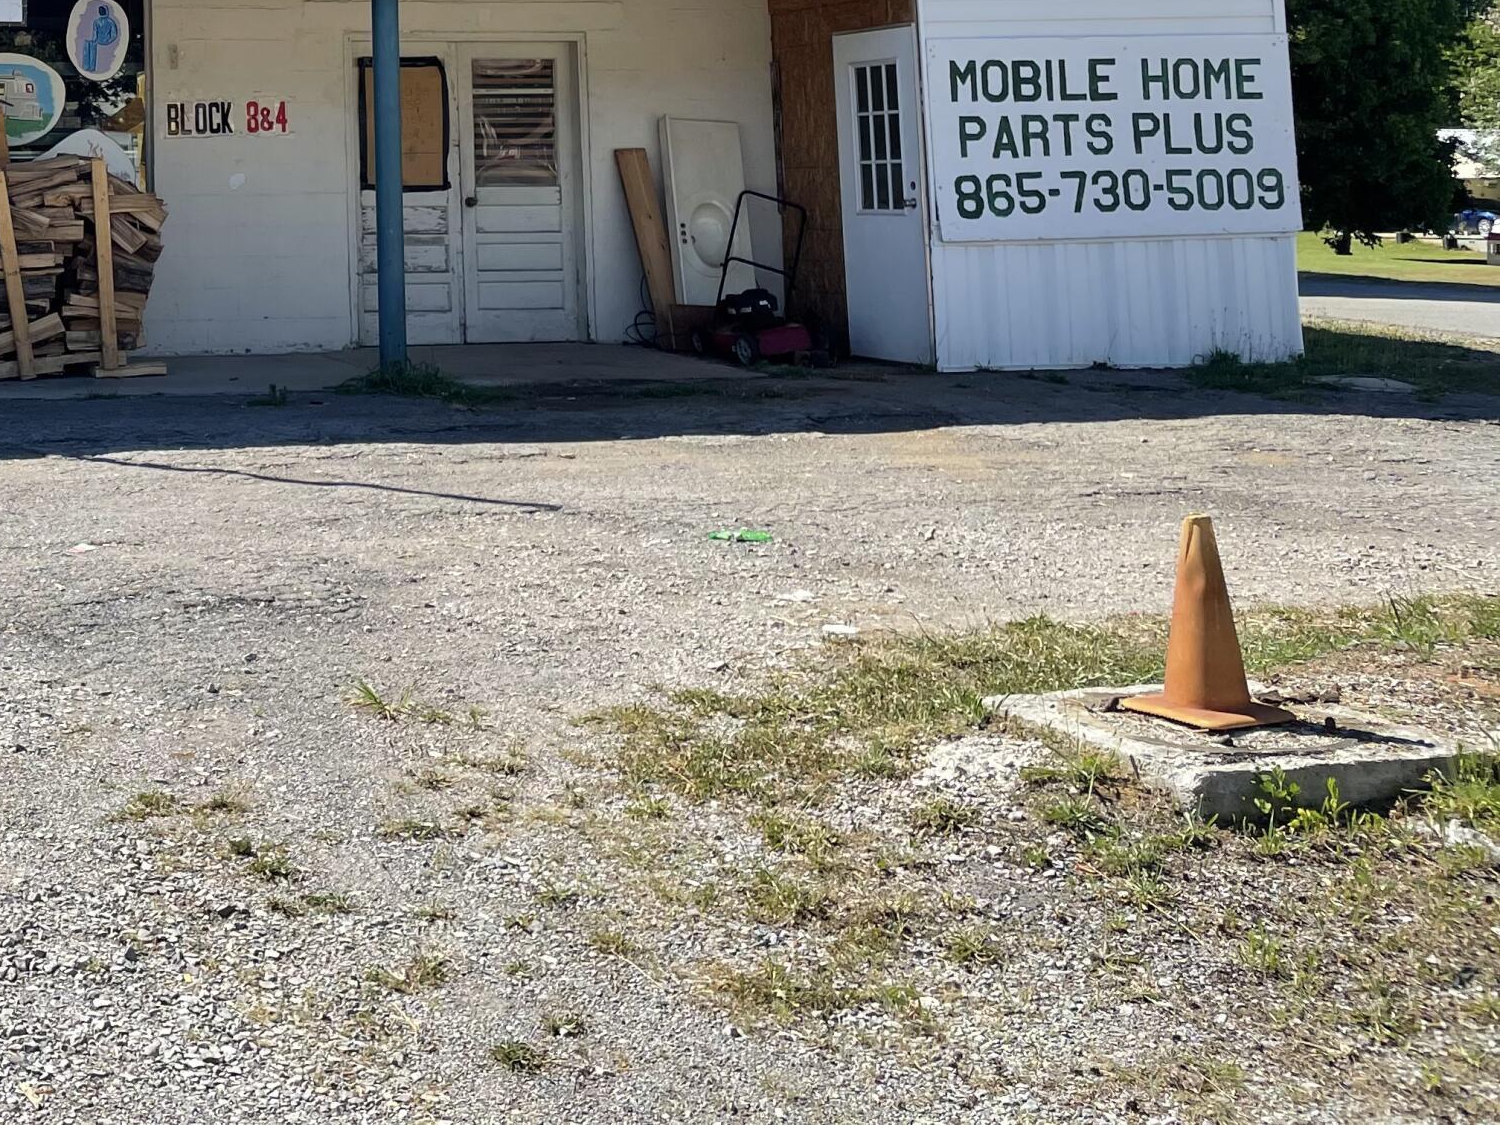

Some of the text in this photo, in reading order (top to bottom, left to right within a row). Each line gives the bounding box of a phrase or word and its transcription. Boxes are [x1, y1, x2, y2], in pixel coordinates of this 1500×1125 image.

[949, 58, 1264, 103] MOBILE HOME
[167, 101, 288, 135] BLOCK 8&4
[959, 112, 1254, 158] PARTS PLUS
[954, 167, 1285, 220] 865-730-5009
